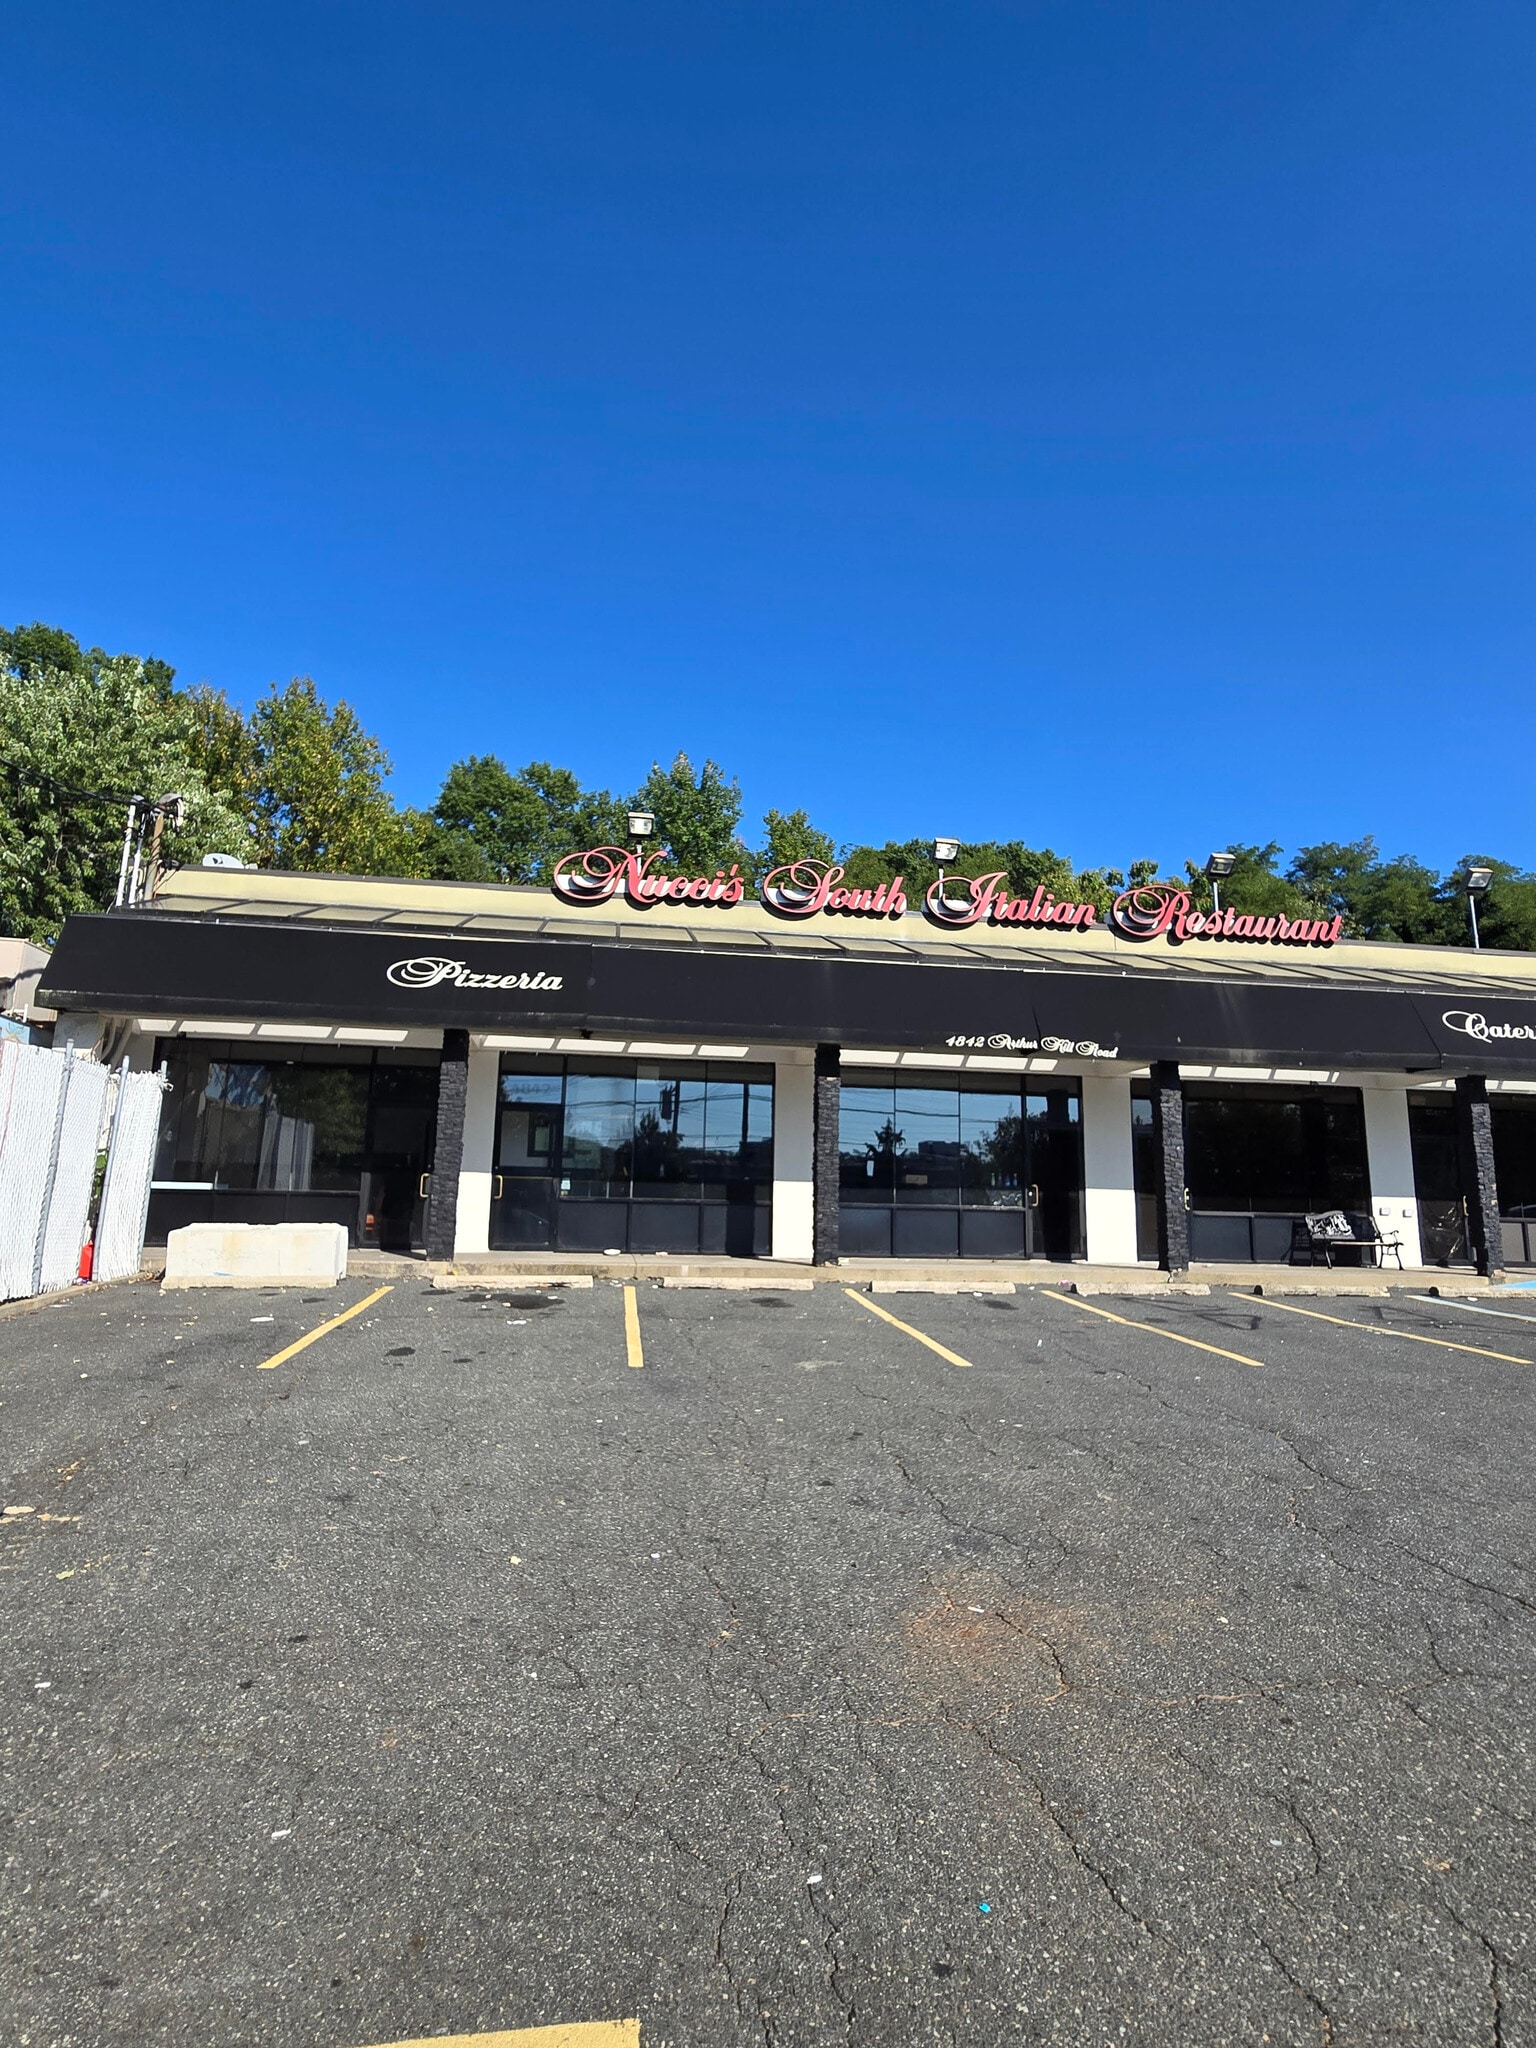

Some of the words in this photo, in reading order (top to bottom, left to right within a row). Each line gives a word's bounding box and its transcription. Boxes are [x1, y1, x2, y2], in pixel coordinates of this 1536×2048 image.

[552, 846, 745, 904] Nucci's
[762, 857, 908, 915] South
[926, 871, 1097, 927] Italian
[1112, 884, 1343, 943] Restaurant
[386, 956, 564, 991] Pizzeria
[1442, 1010, 1536, 1044] Cater
[987, 1033, 1039, 1050] Arthur
[1040, 1036, 1075, 1054] Kill
[1075, 1041, 1119, 1059] Road
